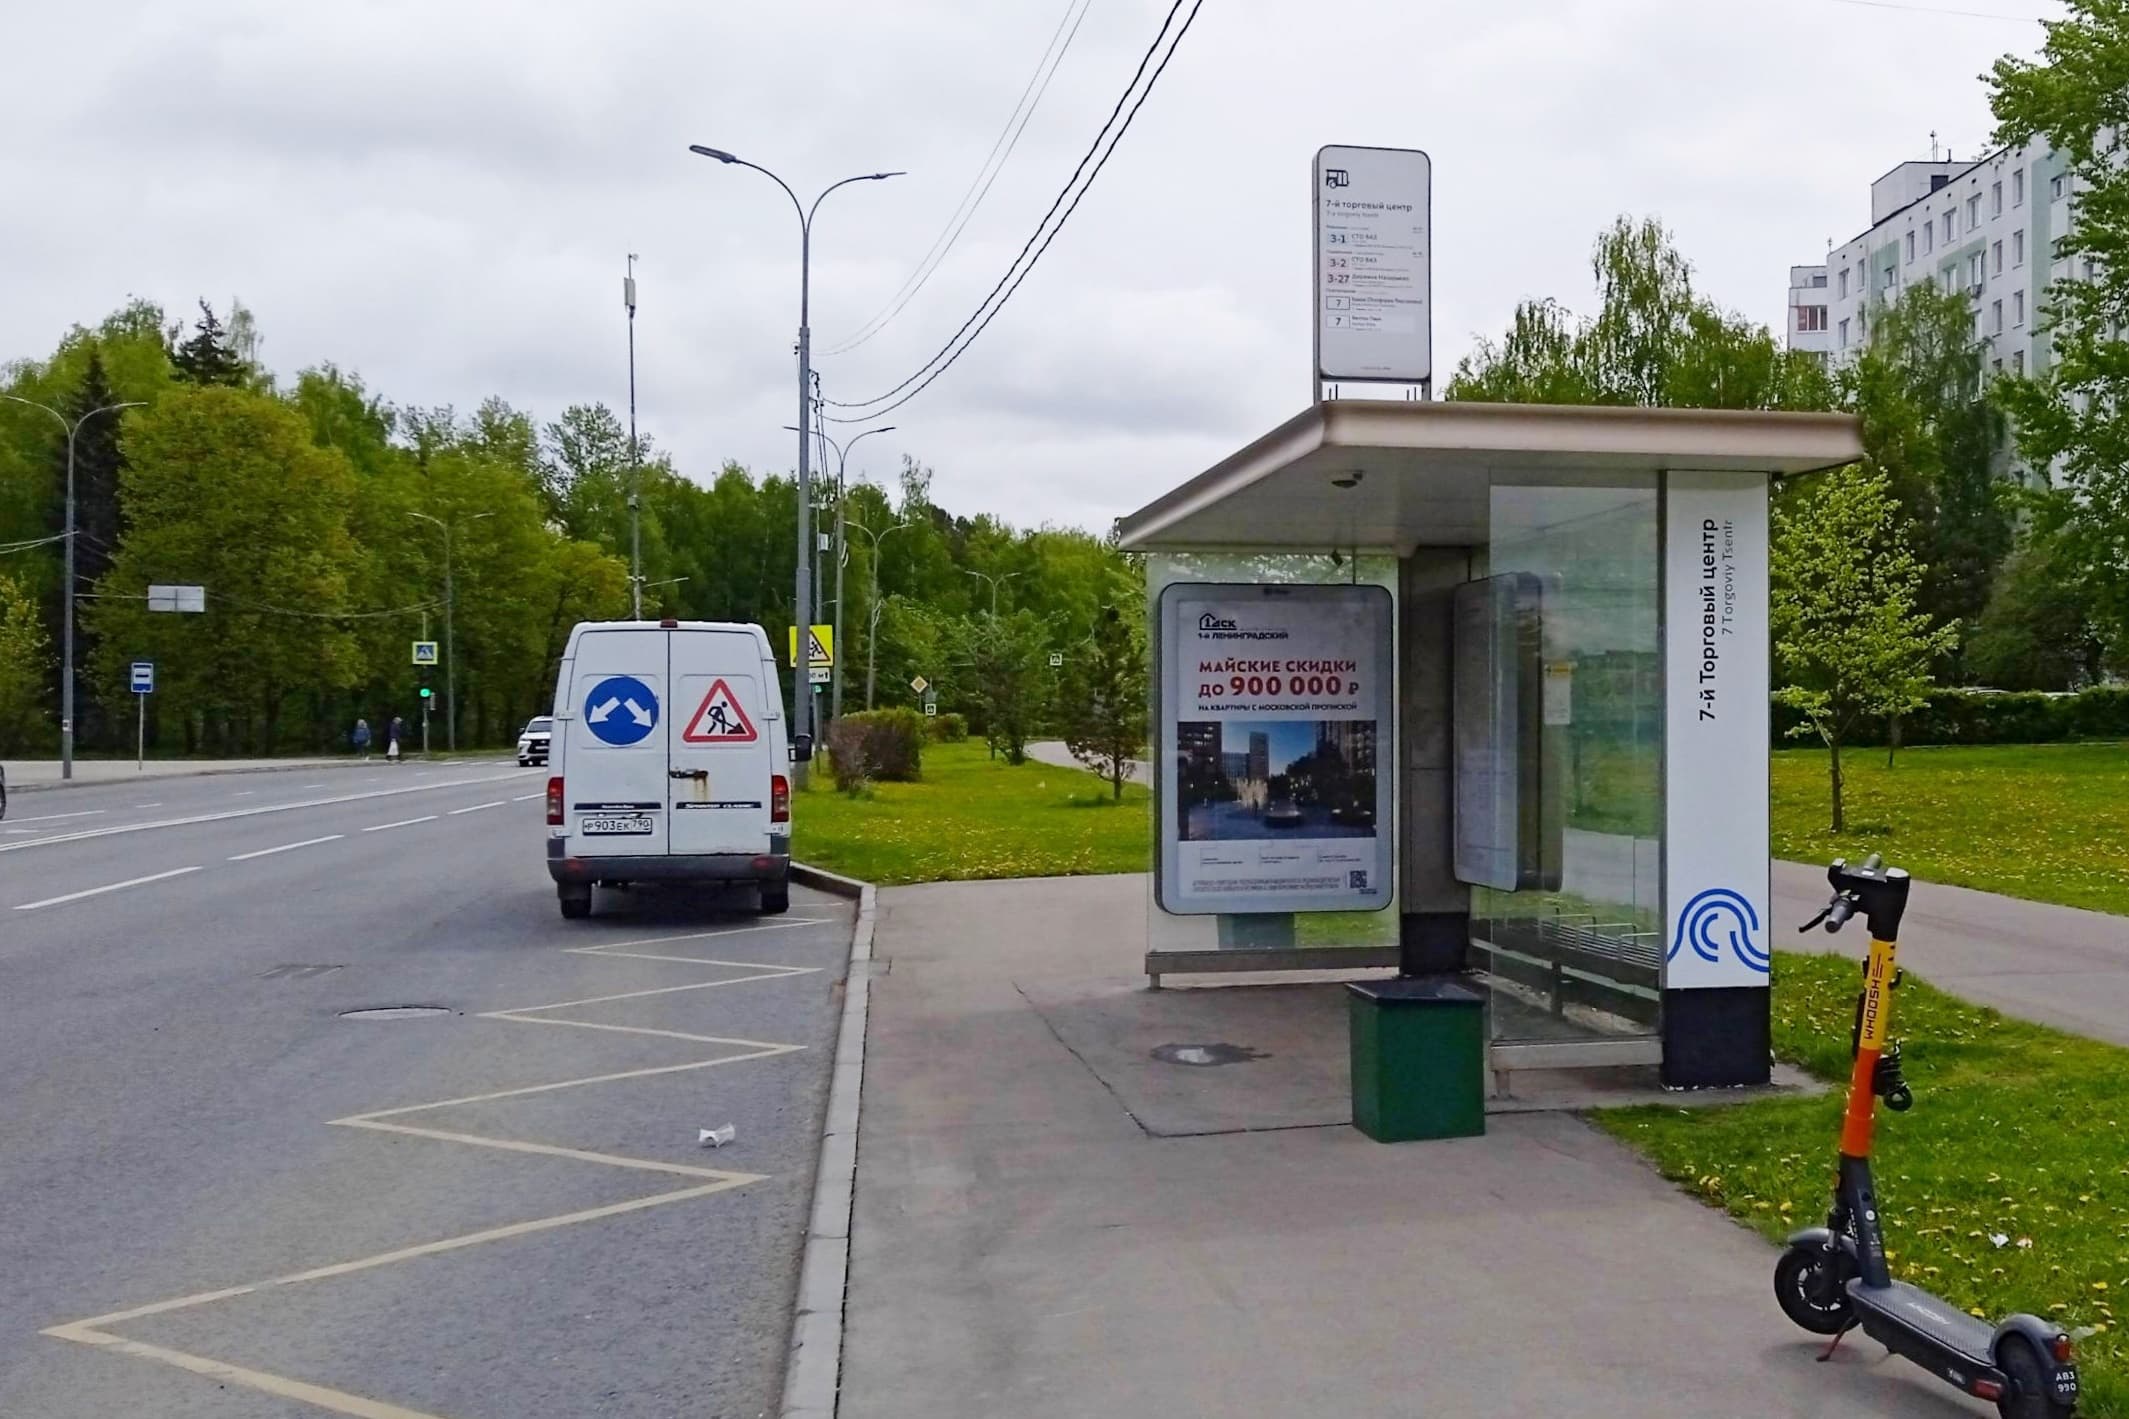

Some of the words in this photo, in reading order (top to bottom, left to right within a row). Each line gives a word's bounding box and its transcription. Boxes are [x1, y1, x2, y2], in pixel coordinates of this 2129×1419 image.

[1326, 200, 1340, 208] 7-й
[1343, 201, 1385, 210] торговый
[1386, 204, 1412, 212] центр
[1336, 299, 1341, 307] 7
[1336, 317, 1341, 326] 7
[1703, 519, 1718, 579] центр
[1722, 564, 1736, 624] Torgoviy
[1212, 631, 1289, 640] ЛЕНИНГРАДСКИЙ
[1699, 586, 1718, 683] Торговый
[1722, 626, 1733, 635] 7
[1199, 657, 1280, 673] МАЙСКИЕ
[1286, 660, 1356, 674] СКИДКИ
[1230, 676, 1282, 696] 900
[1289, 676, 1341, 696] 000
[1210, 704, 1250, 712] КВАРТИРЫ
[1258, 702, 1311, 711] МОСКОВСКОЙ
[1699, 690, 1715, 720] 7-й
[1864, 979, 1881, 1040] WHOOSH
